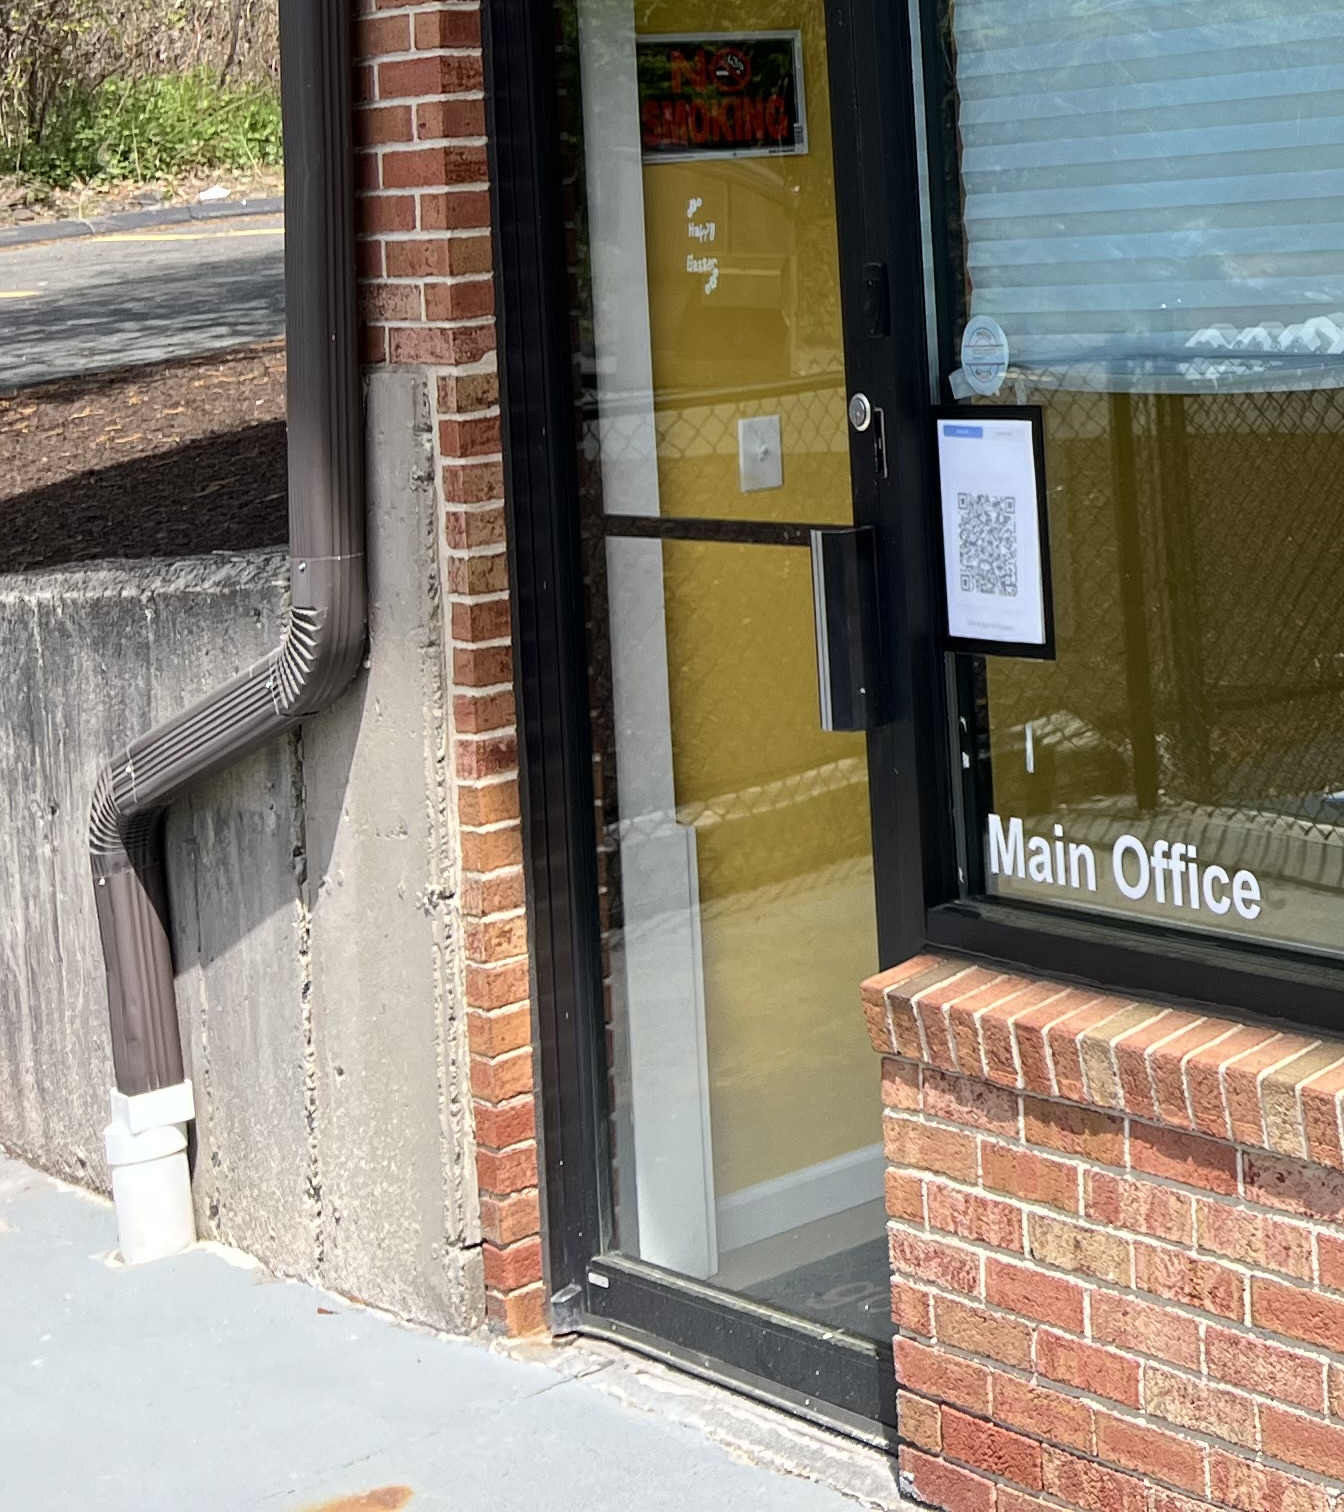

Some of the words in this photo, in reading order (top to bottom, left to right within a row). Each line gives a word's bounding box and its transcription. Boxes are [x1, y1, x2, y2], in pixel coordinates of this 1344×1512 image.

[641, 94, 789, 146] SMOKING
[988, 813, 1098, 892] Main
[1112, 833, 1262, 920] Office
